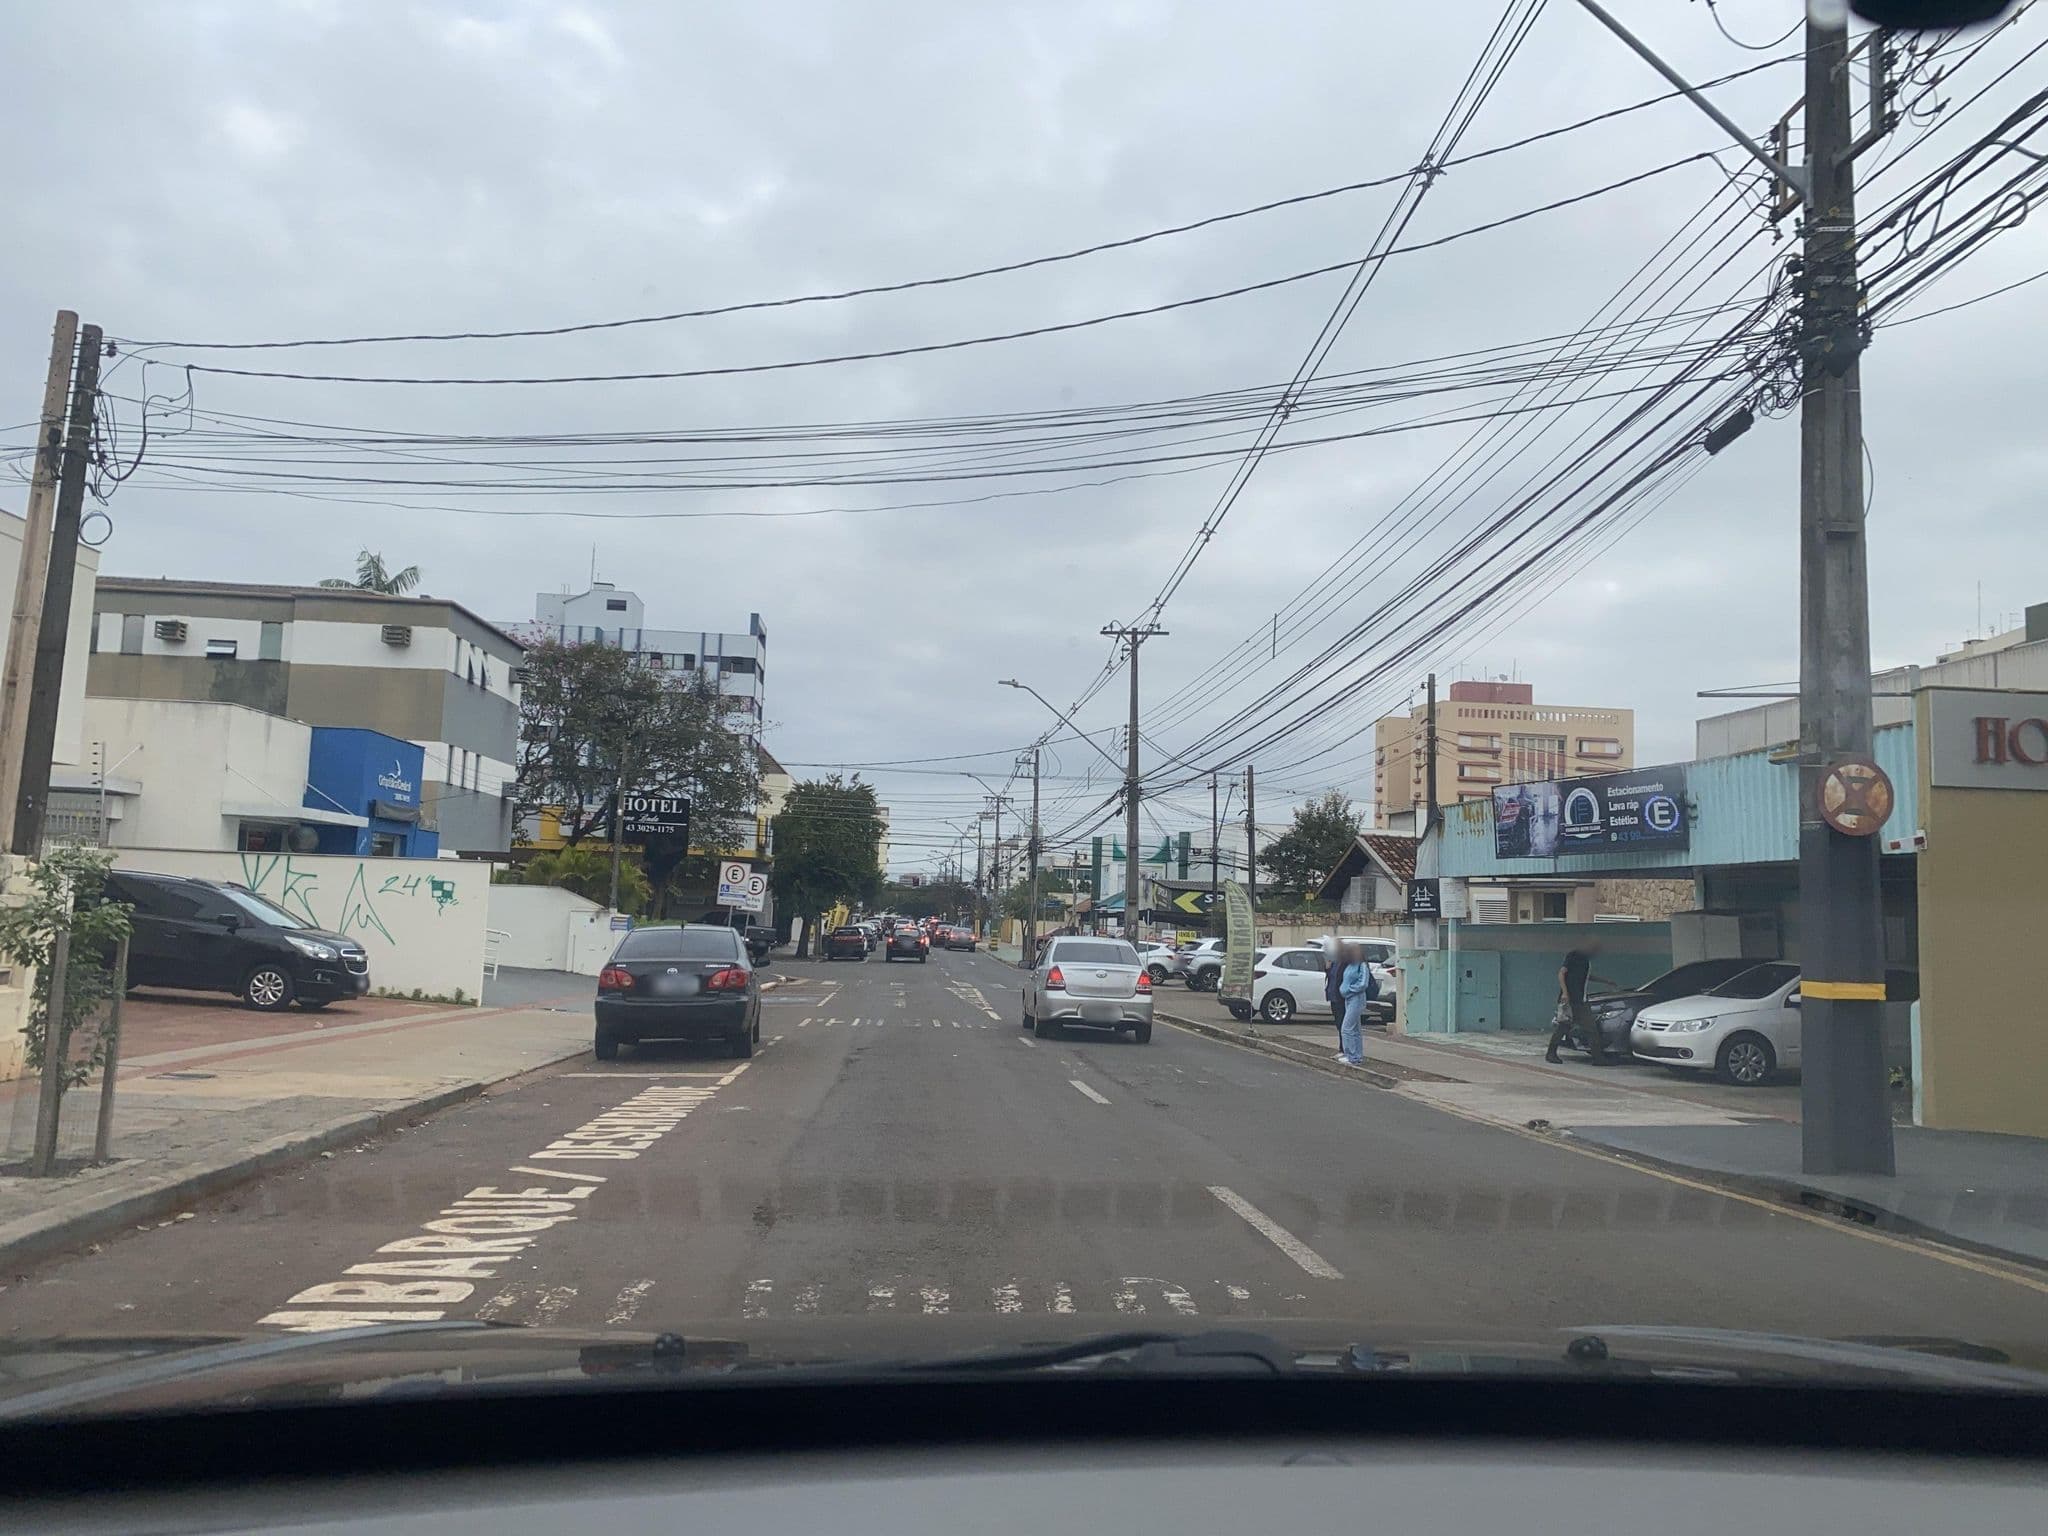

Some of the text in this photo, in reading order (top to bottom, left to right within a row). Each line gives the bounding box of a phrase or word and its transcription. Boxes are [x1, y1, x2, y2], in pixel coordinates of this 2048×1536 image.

[1607, 782, 1664, 797] Estacionamento
[623, 797, 683, 814] HOTEL
[1608, 802, 1626, 812] Lava
[1653, 802, 1671, 824] E
[1609, 816, 1639, 827] Estética
[625, 824, 635, 832] 43
[731, 869, 740, 880] E
[751, 880, 759, 891] E
[529, 1085, 721, 1160] DESEMBARQUE
